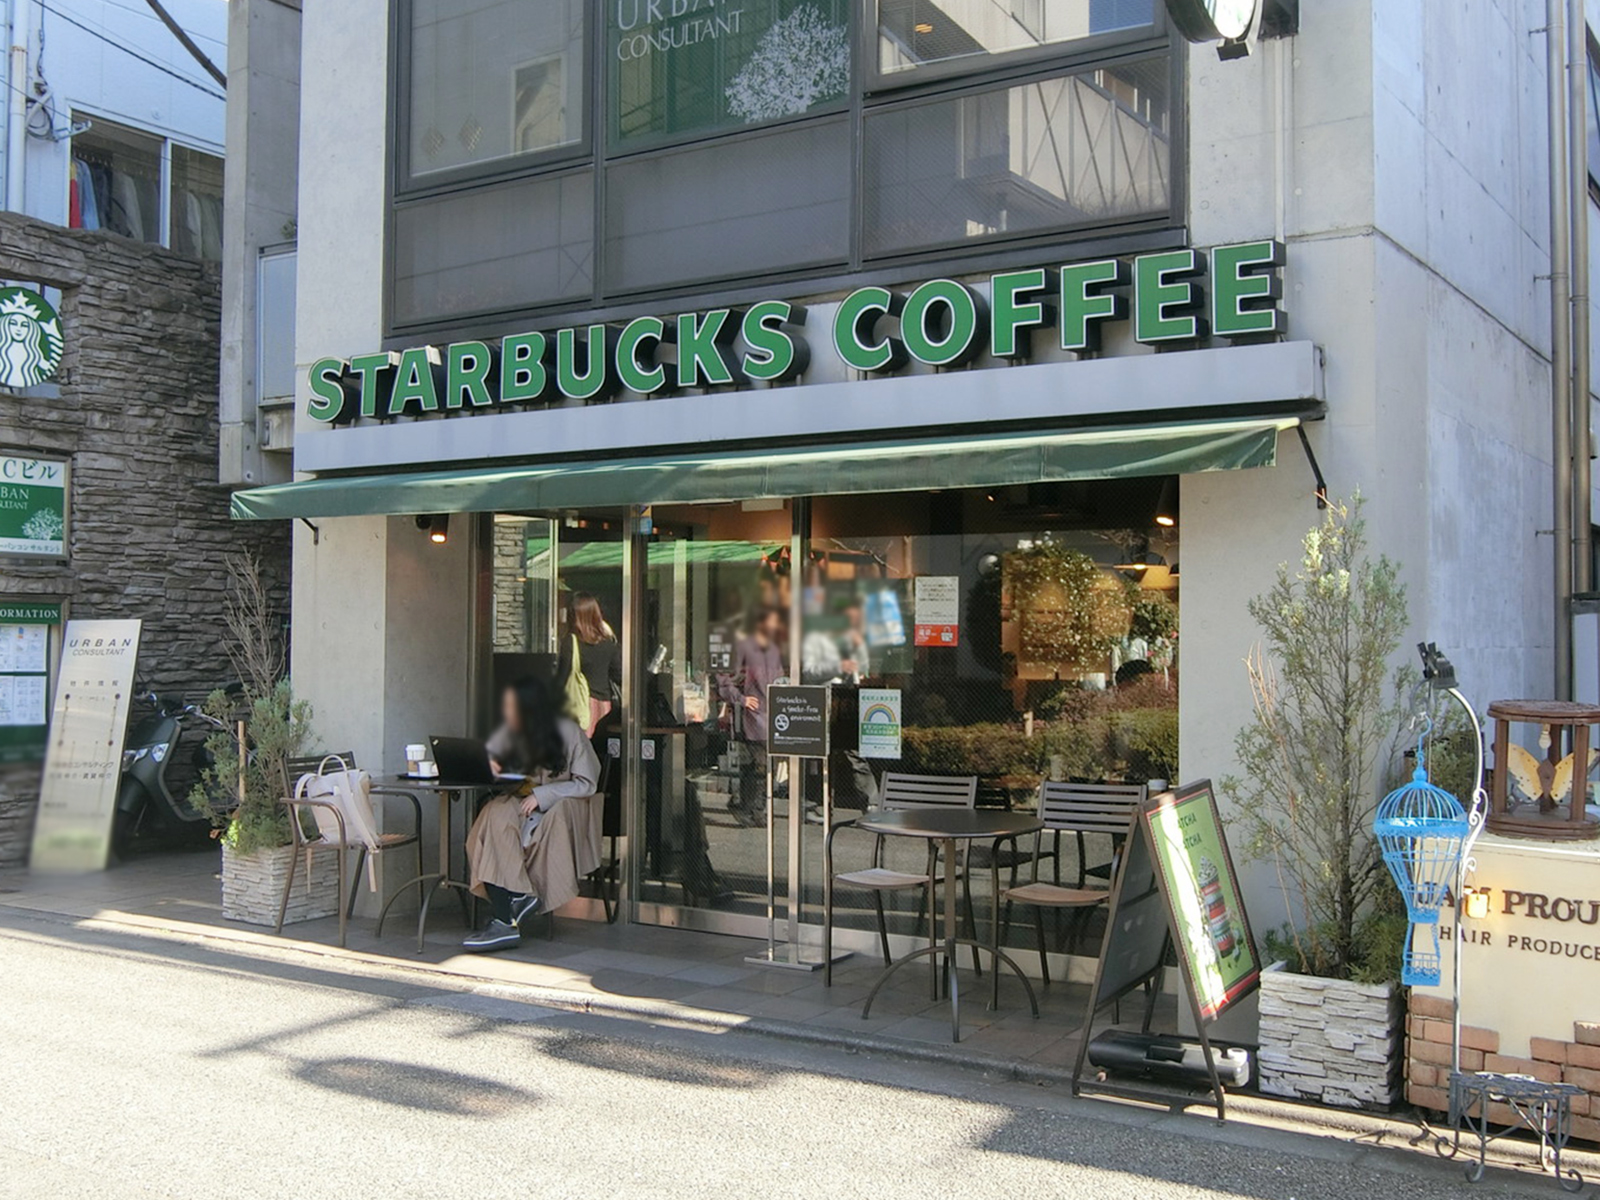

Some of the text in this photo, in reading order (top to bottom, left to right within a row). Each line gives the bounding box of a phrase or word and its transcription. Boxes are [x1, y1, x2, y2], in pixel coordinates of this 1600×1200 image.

[617, 9, 744, 61] CONSULTANT
[307, 240, 1286, 423] STARBUCKS COFFEE
[69, 638, 131, 648] URBAN
[72, 648, 125, 657] CONSULTANT
